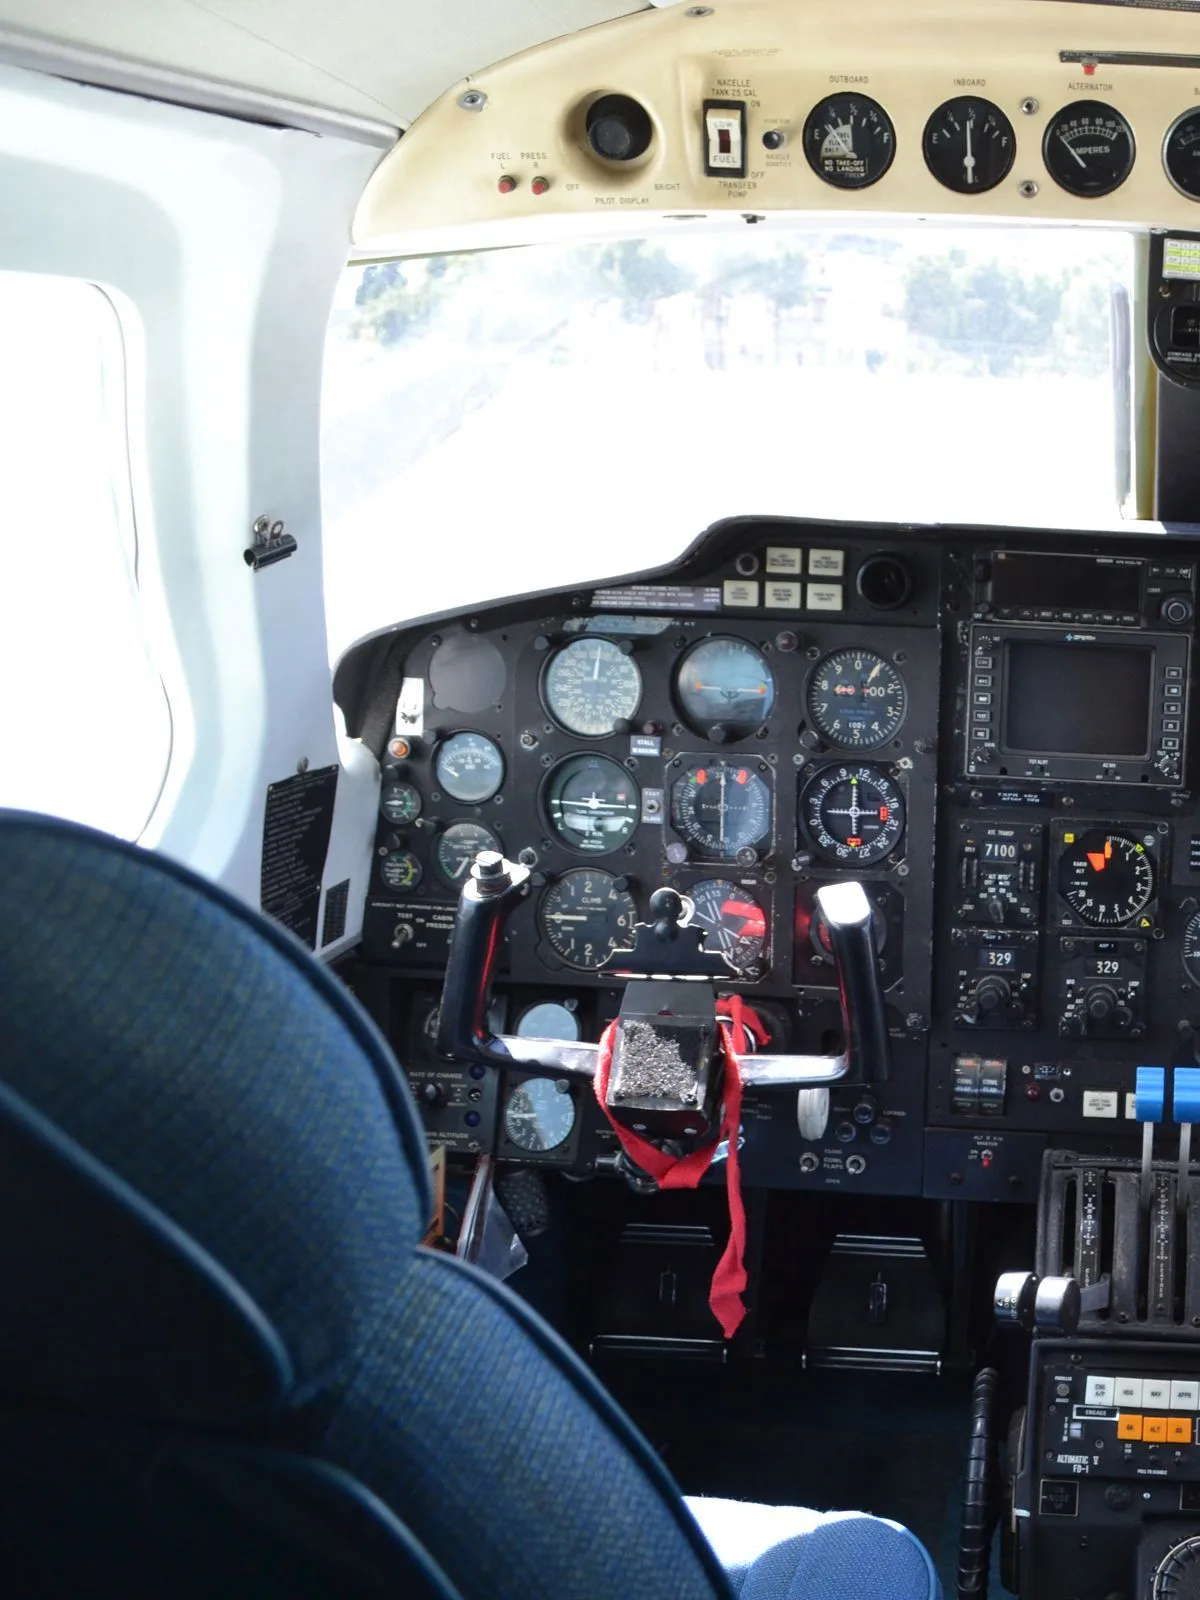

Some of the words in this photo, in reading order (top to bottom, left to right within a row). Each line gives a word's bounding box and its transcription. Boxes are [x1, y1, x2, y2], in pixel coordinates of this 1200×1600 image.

[716, 79, 752, 88] NACELLE
[829, 76, 869, 84] OUTBOARD
[953, 79, 986, 87] INBOARD
[1068, 82, 1114, 92] ALTERNATOR
[712, 88, 730, 96] TANK
[732, 88, 740, 96] 25
[742, 88, 758, 97] GAL
[750, 99, 761, 107] ON
[713, 120, 733, 128] LOW
[814, 128, 820, 140] E
[883, 132, 890, 143] F
[932, 134, 938, 144] E
[1002, 137, 1008, 147] F
[491, 152, 512, 160] FUEL
[519, 152, 549, 160] PRESS
[713, 155, 738, 164] FUEL
[750, 171, 765, 179] OFF
[566, 183, 580, 191] OFF
[654, 183, 680, 191] BRIGHT
[720, 181, 758, 190] TRANSFER
[727, 190, 747, 198] PUMP
[594, 197, 617, 205] PILOT
[620, 198, 650, 206] DISPLAY
[858, 768, 870, 777] 12
[876, 778, 890, 790] 15
[890, 796, 899, 808] 18
[892, 819, 900, 832] 21
[818, 834, 832, 847] 33
[877, 837, 890, 849] 24
[836, 846, 849, 858] 30
[858, 846, 870, 857] 27
[985, 843, 1015, 858] 7100
[1126, 852, 1129, 861] 1
[1135, 866, 1140, 875] 2
[1136, 883, 1141, 892] 3
[1078, 889, 1085, 897] 20
[1128, 896, 1133, 904] 4
[1114, 904, 1119, 913] 5
[989, 952, 1012, 966] 329
[1097, 961, 1119, 974] 329
[1056, 1454, 1089, 1464] ALTIMATIC
